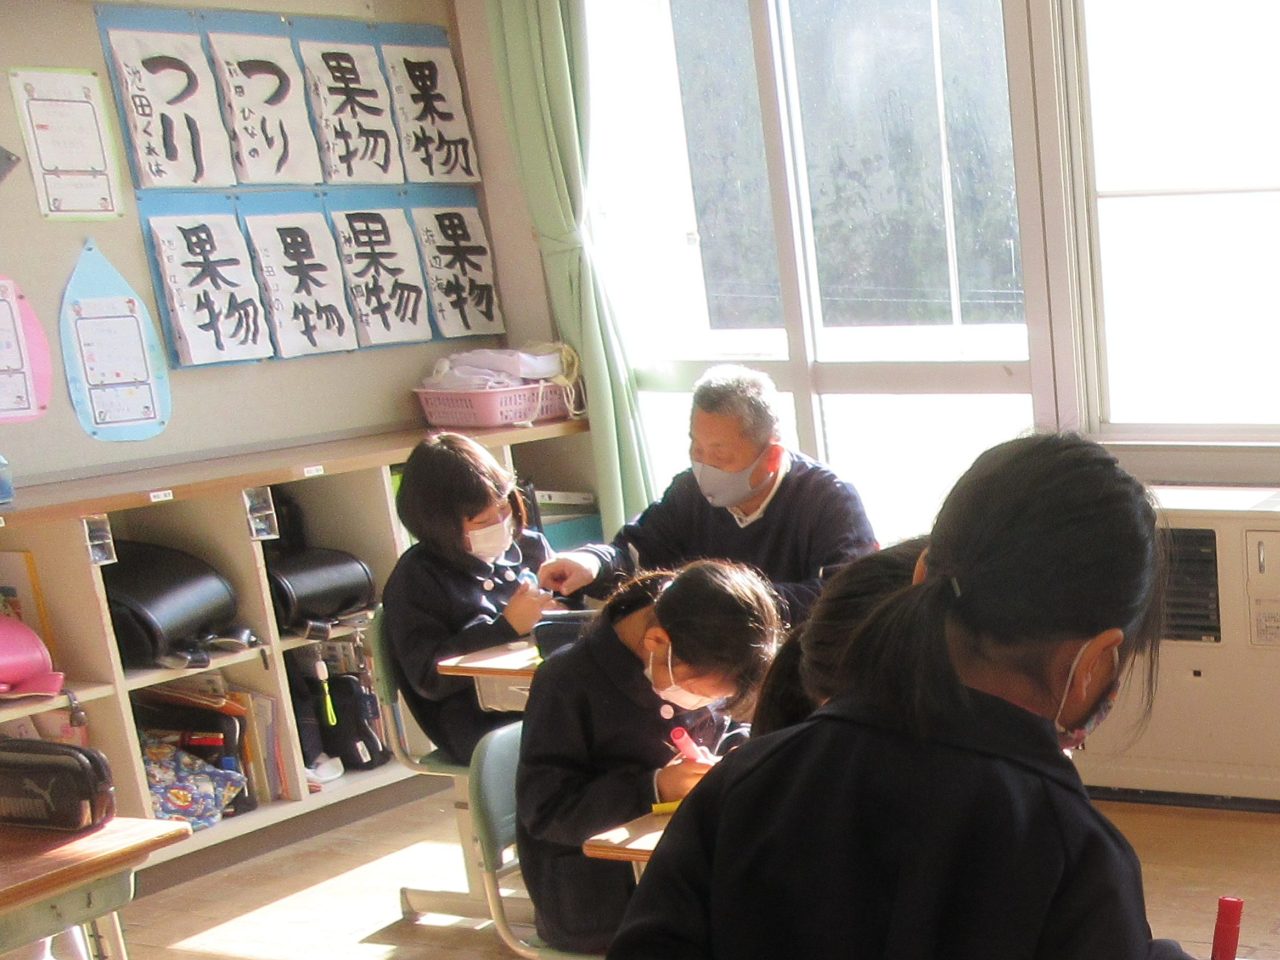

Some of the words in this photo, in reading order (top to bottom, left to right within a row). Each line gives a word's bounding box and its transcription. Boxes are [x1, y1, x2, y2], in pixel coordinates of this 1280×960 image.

[141, 55, 204, 183] つり
[237, 59, 291, 174] つり
[321, 52, 391, 177] 果物
[403, 57, 474, 176] 果物
[177, 224, 260, 351] 果物
[276, 227, 345, 347] 果物
[345, 212, 423, 331] 果物
[434, 212, 494, 330] 果物
